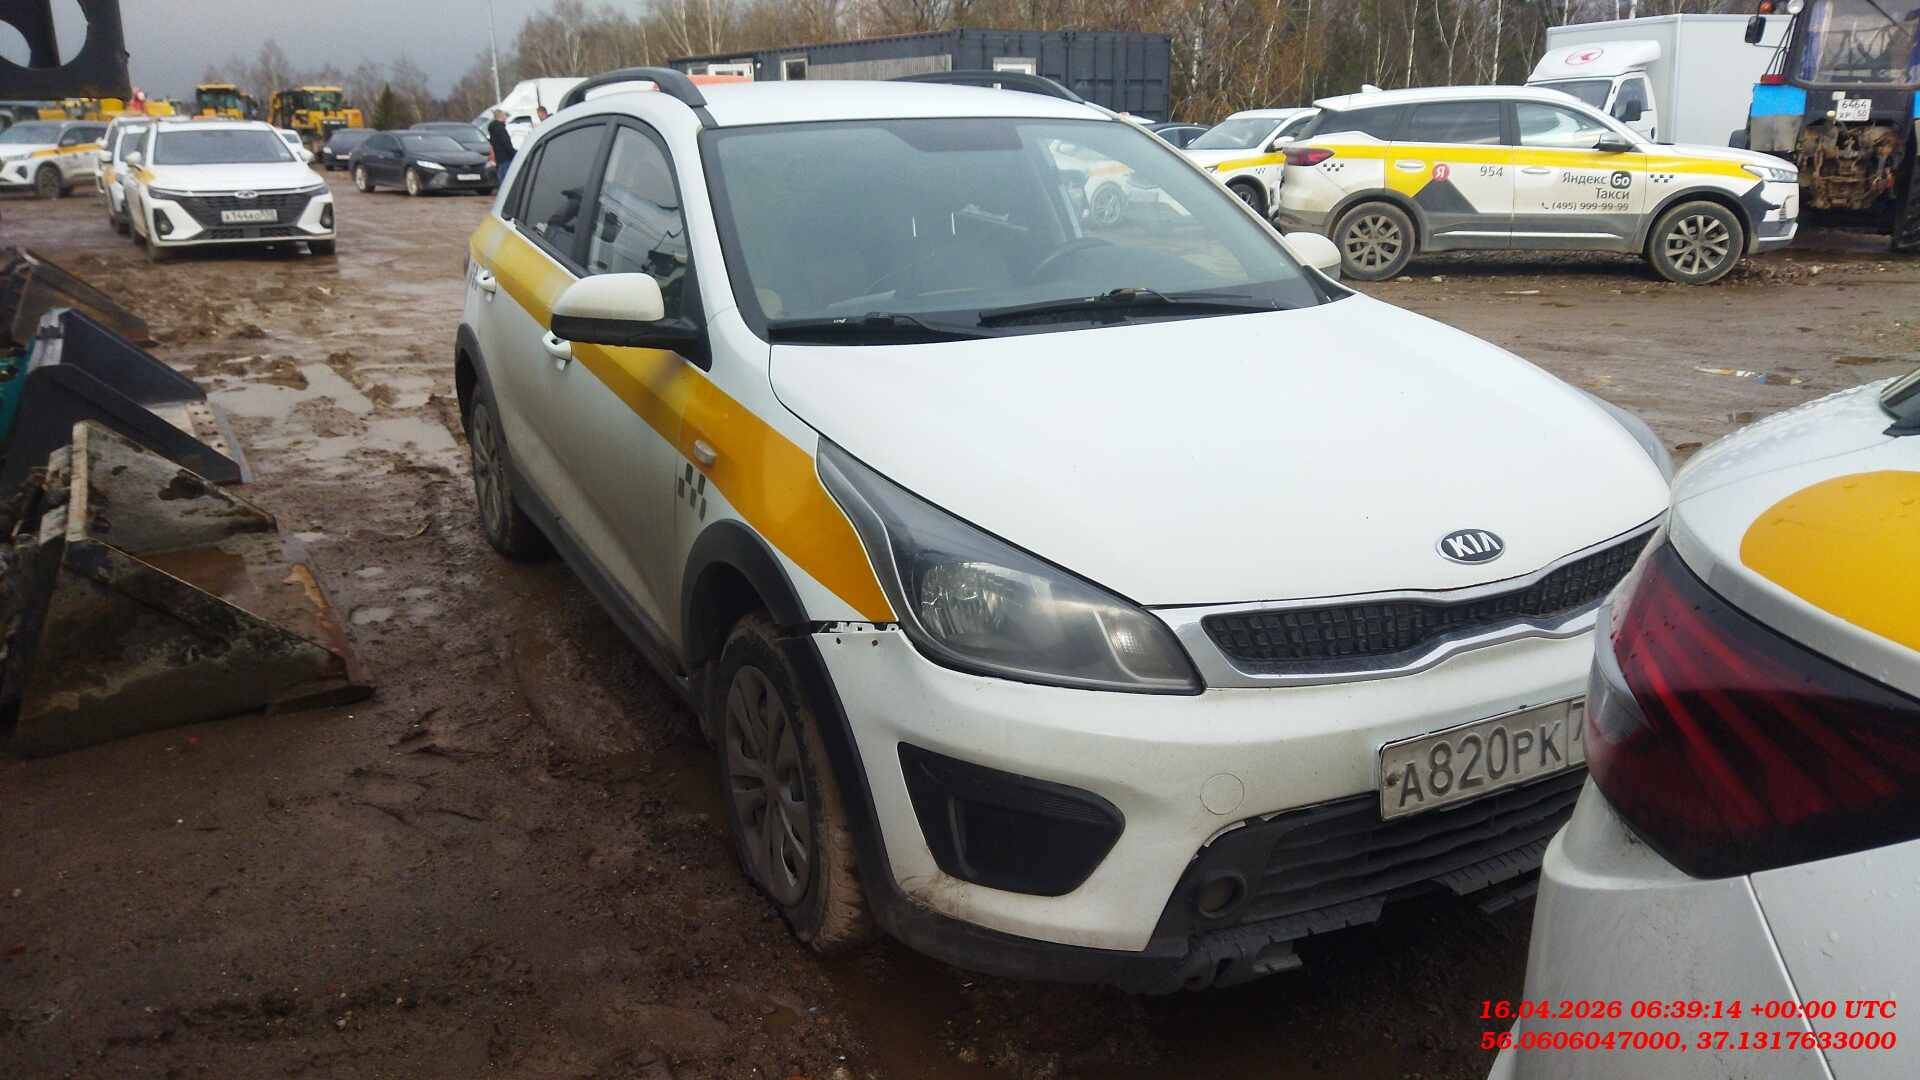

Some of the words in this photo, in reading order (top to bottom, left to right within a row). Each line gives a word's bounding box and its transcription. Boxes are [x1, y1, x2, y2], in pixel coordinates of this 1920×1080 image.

[1435, 165, 1446, 179] Я
[1480, 165, 1504, 177] 954
[1562, 171, 1608, 185] Яндекс
[1612, 173, 1630, 186] Go
[1595, 187, 1630, 200] Такси
[1552, 201, 1577, 211] (495)
[1579, 202, 1630, 211] 999-99-99
[1445, 532, 1501, 558] KIA
[1399, 720, 1562, 807] А820РК
